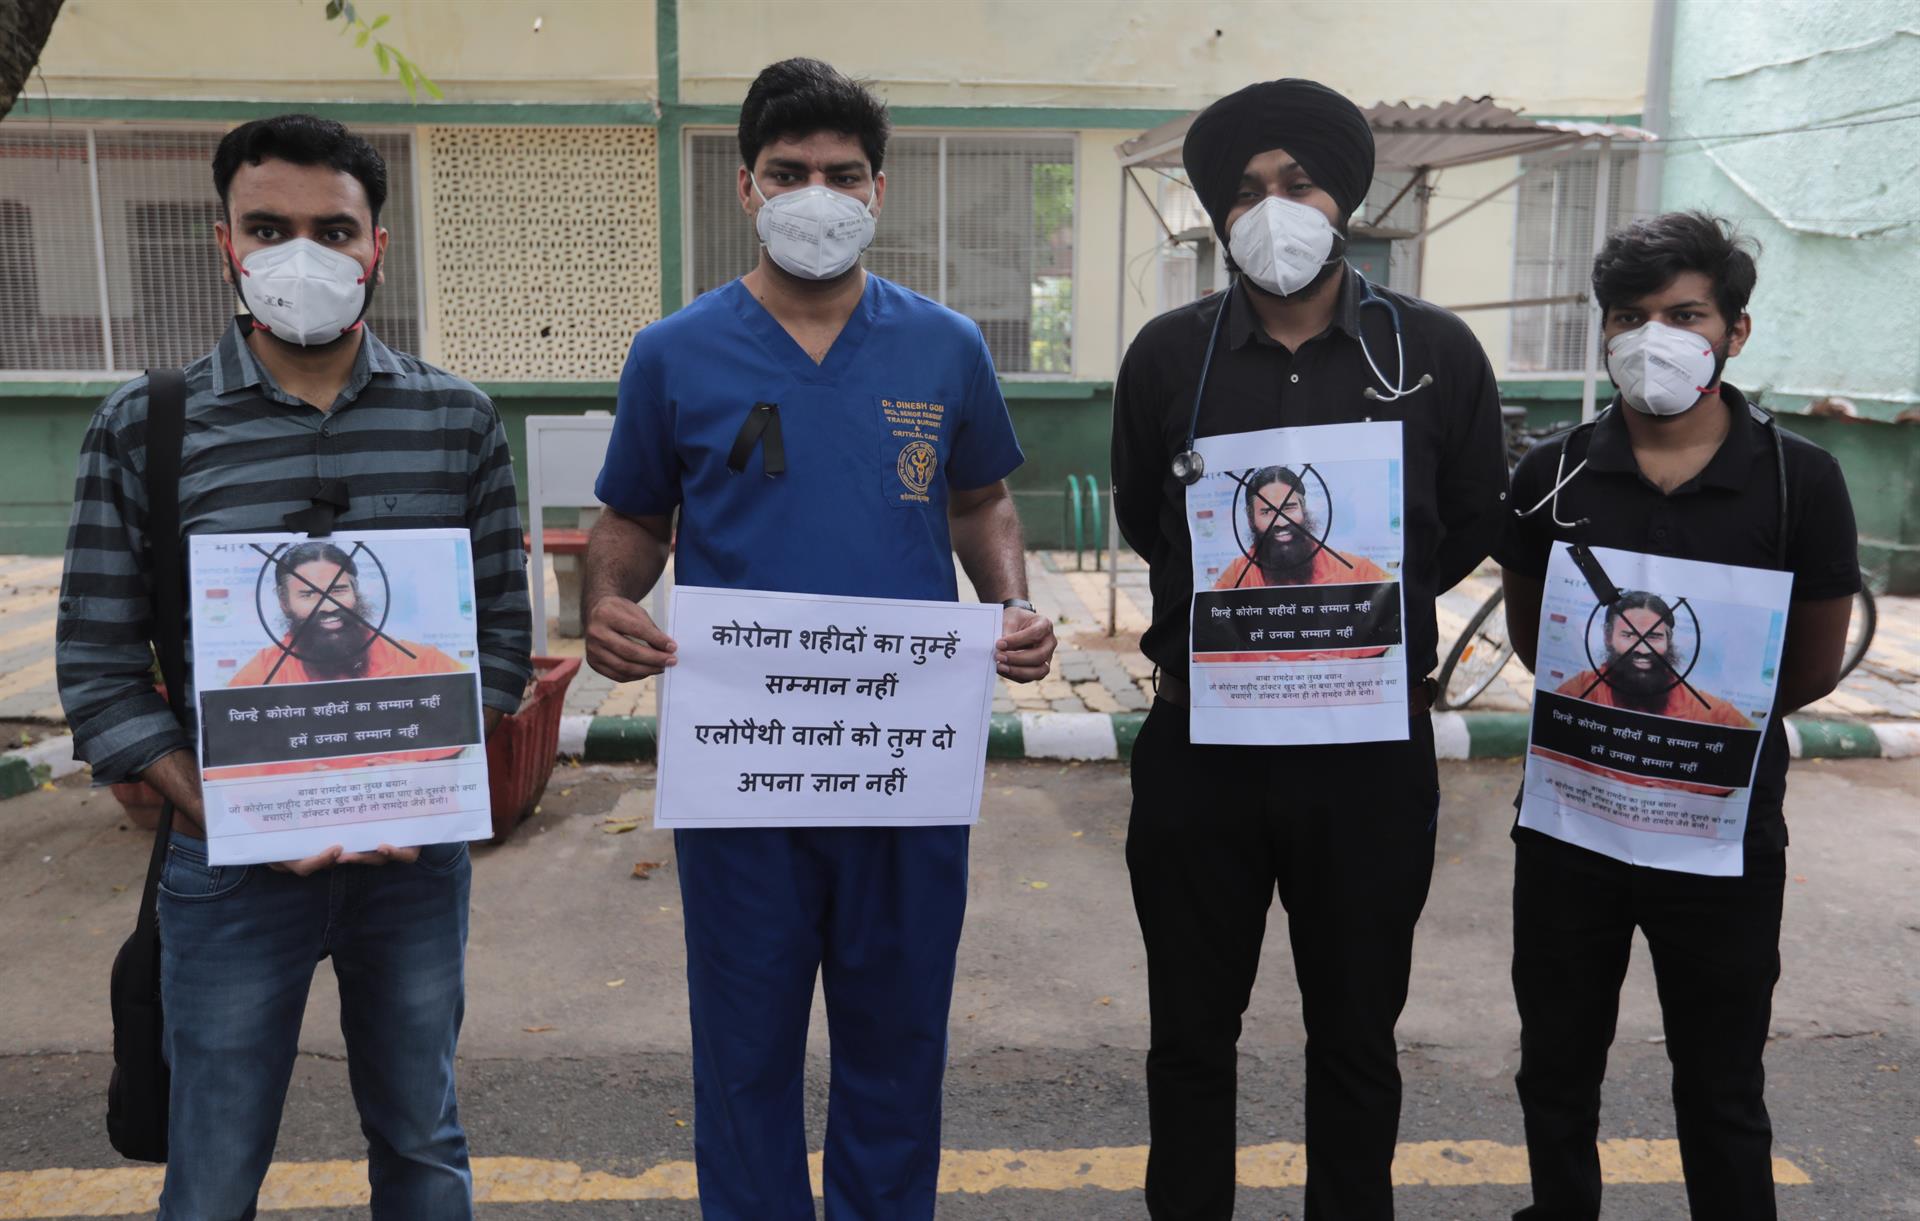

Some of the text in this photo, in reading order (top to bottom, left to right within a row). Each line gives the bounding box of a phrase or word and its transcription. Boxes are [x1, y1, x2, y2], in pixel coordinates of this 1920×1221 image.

[896, 401, 927, 409] DINESH
[893, 430, 923, 438] CRITICAL
[1236, 606, 1262, 616] कोरोना
[1268, 604, 1296, 616] शहीदों
[1302, 606, 1314, 614] का
[1320, 605, 1349, 613] सम्मान
[1355, 601, 1371, 612] नहीं
[712, 620, 960, 664] कोरोना शहीदों का तुम्हें
[1250, 626, 1353, 641] हमें उनका सम्मान नहीं
[766, 673, 900, 700] सम्मान नहीं
[266, 705, 305, 719] कोरोना
[314, 701, 349, 718] शहीदों
[356, 702, 371, 713] का
[378, 699, 413, 711] सम्मान
[420, 695, 440, 708] नहीं
[290, 724, 419, 747] हमें उनका सम्मान नहीं
[696, 718, 956, 758] एलोपैथी वालों को तुम दो
[737, 768, 907, 796] अपना ज्ञान नहीं
